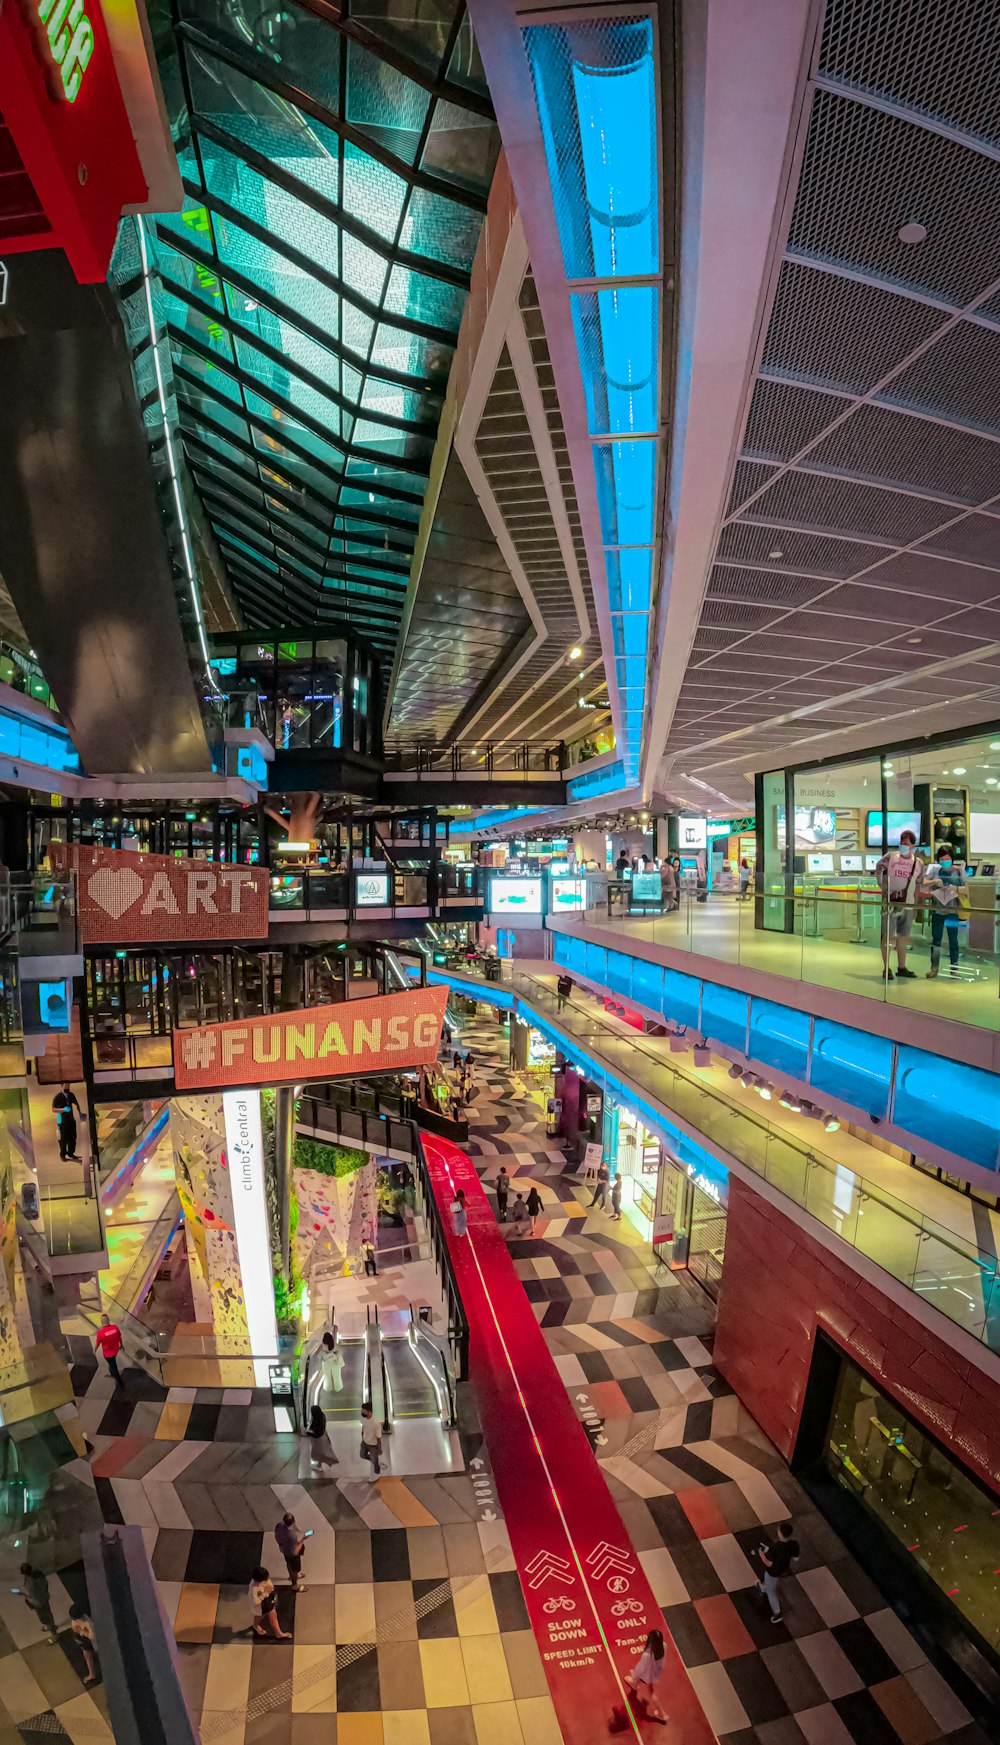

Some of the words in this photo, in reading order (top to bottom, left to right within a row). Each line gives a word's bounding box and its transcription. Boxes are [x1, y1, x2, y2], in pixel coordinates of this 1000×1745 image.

[799, 788, 837, 798] BUSINESS
[141, 871, 252, 915] ART
[183, 1013, 438, 1070] #FUNANSG
[236, 1100, 248, 1148] central
[243, 1153, 254, 1191] climb
[579, 1405, 605, 1433] LOOK
[471, 1472, 495, 1506] LOOK
[547, 1618, 582, 1632] SLOW
[616, 1616, 647, 1629] ONLY
[549, 1628, 587, 1643] DOWN
[615, 1634, 649, 1647] 7am-10
[543, 1649, 576, 1661] SPEED
[576, 1644, 603, 1656] LIMIT
[629, 1645, 646, 1655] ON
[559, 1656, 595, 1669] 10km/h
